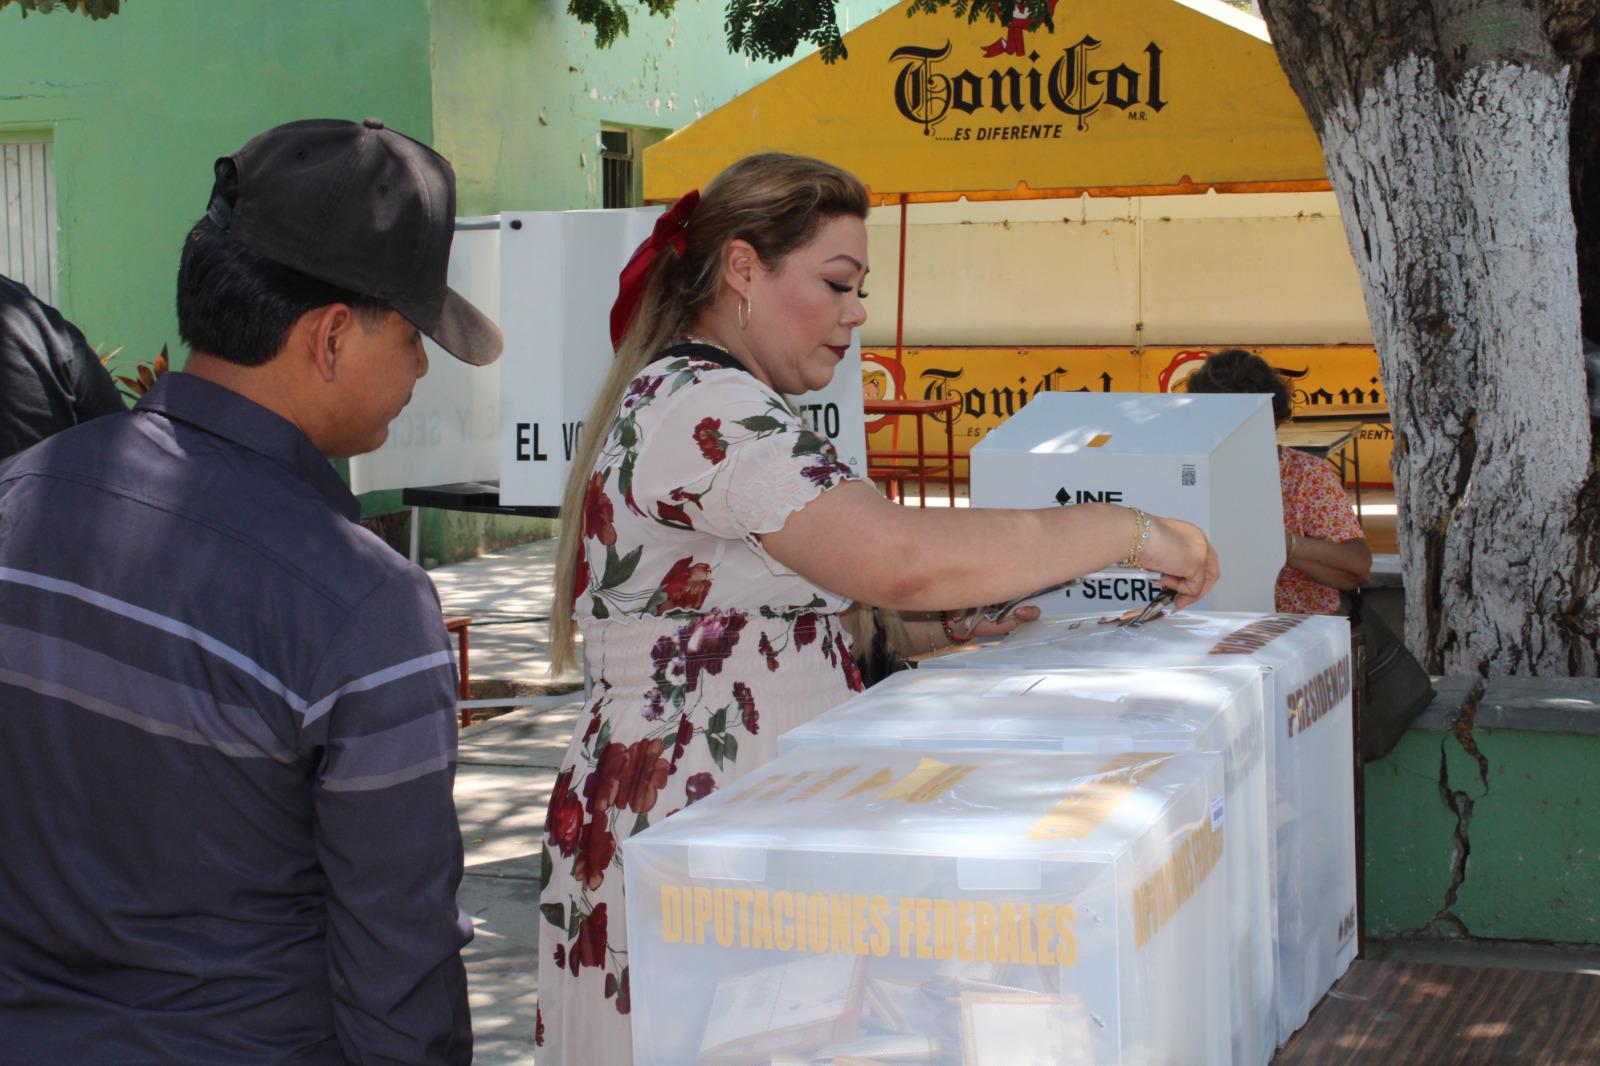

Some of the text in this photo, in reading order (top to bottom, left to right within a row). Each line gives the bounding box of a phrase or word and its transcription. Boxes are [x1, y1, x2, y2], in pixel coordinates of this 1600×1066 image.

[976, 124, 1063, 141] DIFERENTE
[516, 423, 548, 461] EL
[660, 884, 1078, 967] DIPUTACIONES FEDERALES
